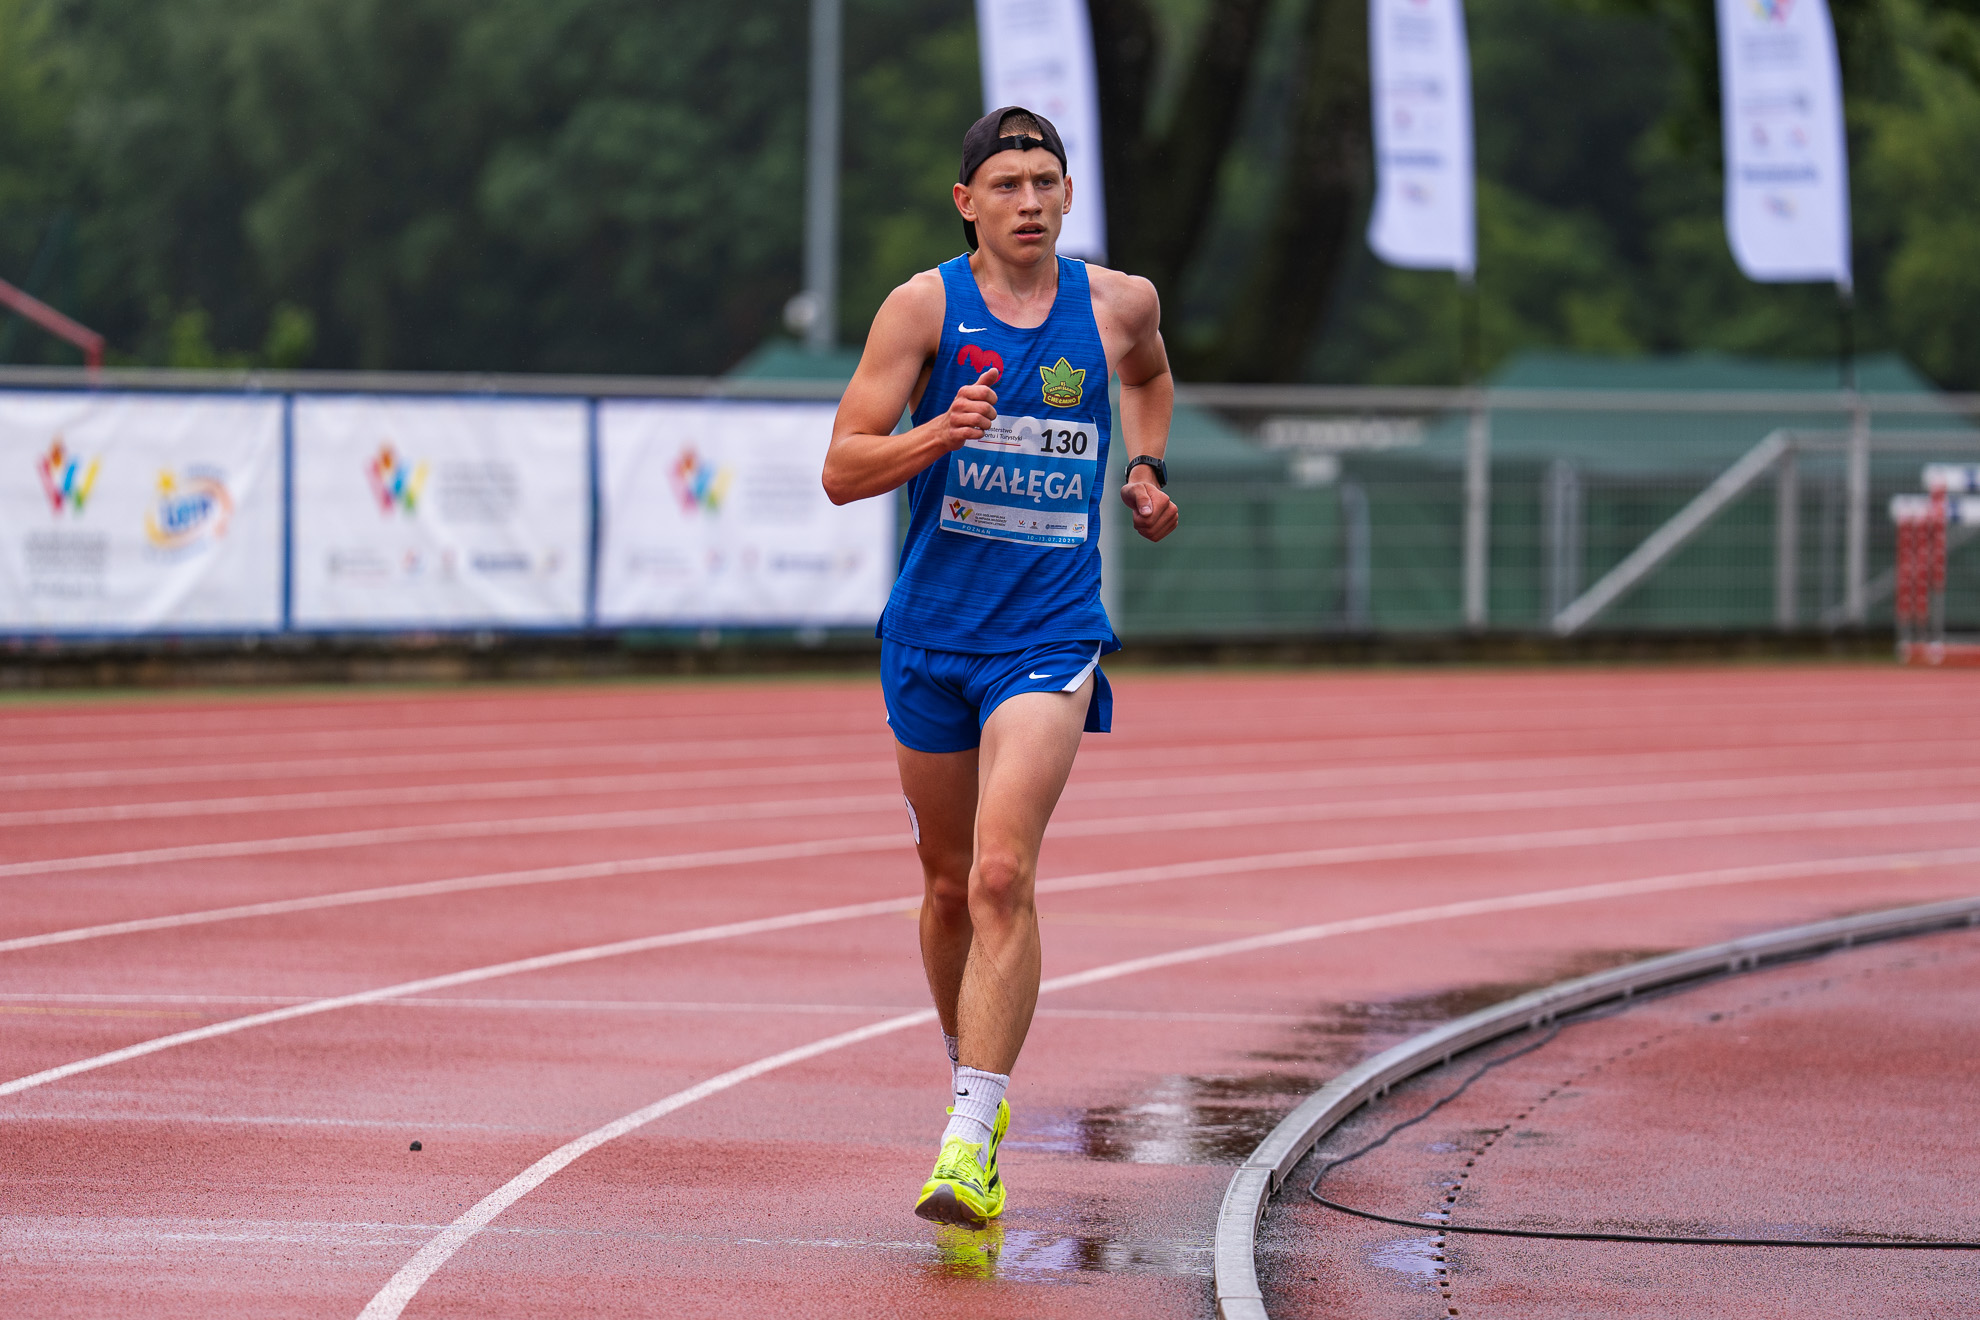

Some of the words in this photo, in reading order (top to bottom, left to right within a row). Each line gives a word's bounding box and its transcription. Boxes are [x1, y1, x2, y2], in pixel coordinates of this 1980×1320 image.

[1040, 428, 1088, 455] 130
[957, 459, 1083, 504] WAŁĘGA
[962, 524, 991, 535] POZNAŃ
